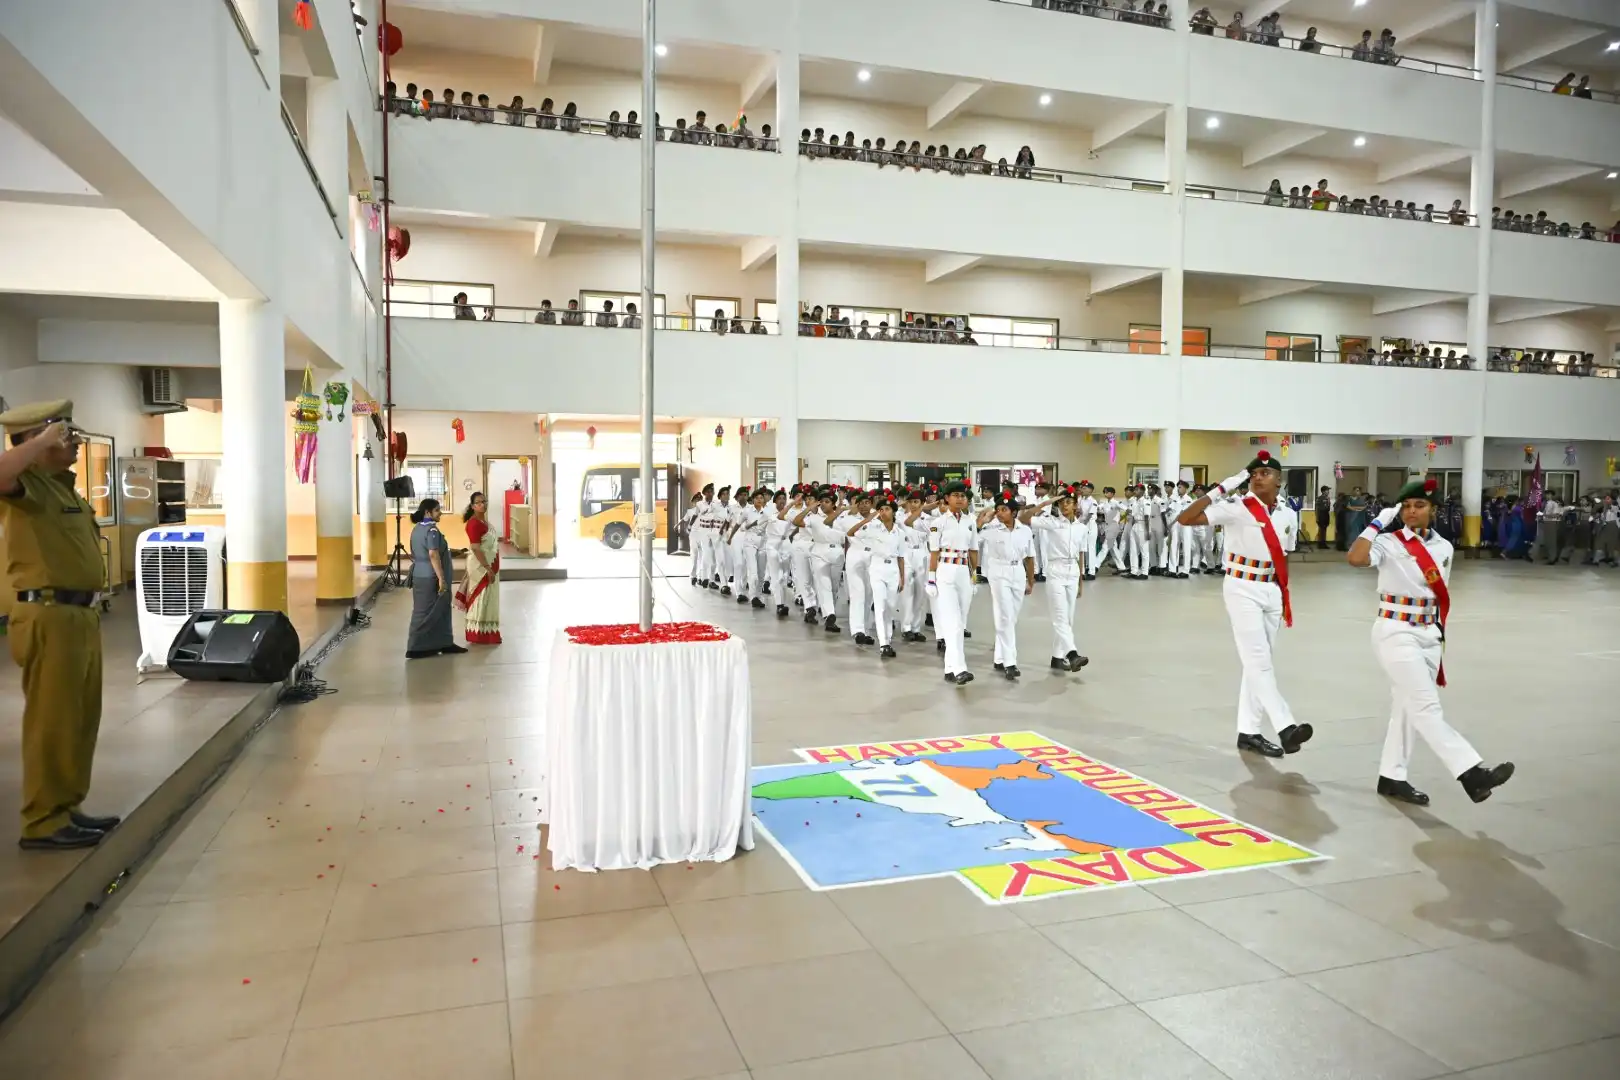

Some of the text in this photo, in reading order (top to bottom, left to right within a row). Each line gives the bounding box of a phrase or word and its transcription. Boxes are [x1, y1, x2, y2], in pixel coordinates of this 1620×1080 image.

[805, 735, 1005, 763] HAPPY
[860, 774, 938, 798] 77
[1018, 745, 1272, 847] REPUBLIC
[1004, 846, 1208, 897] DAY
